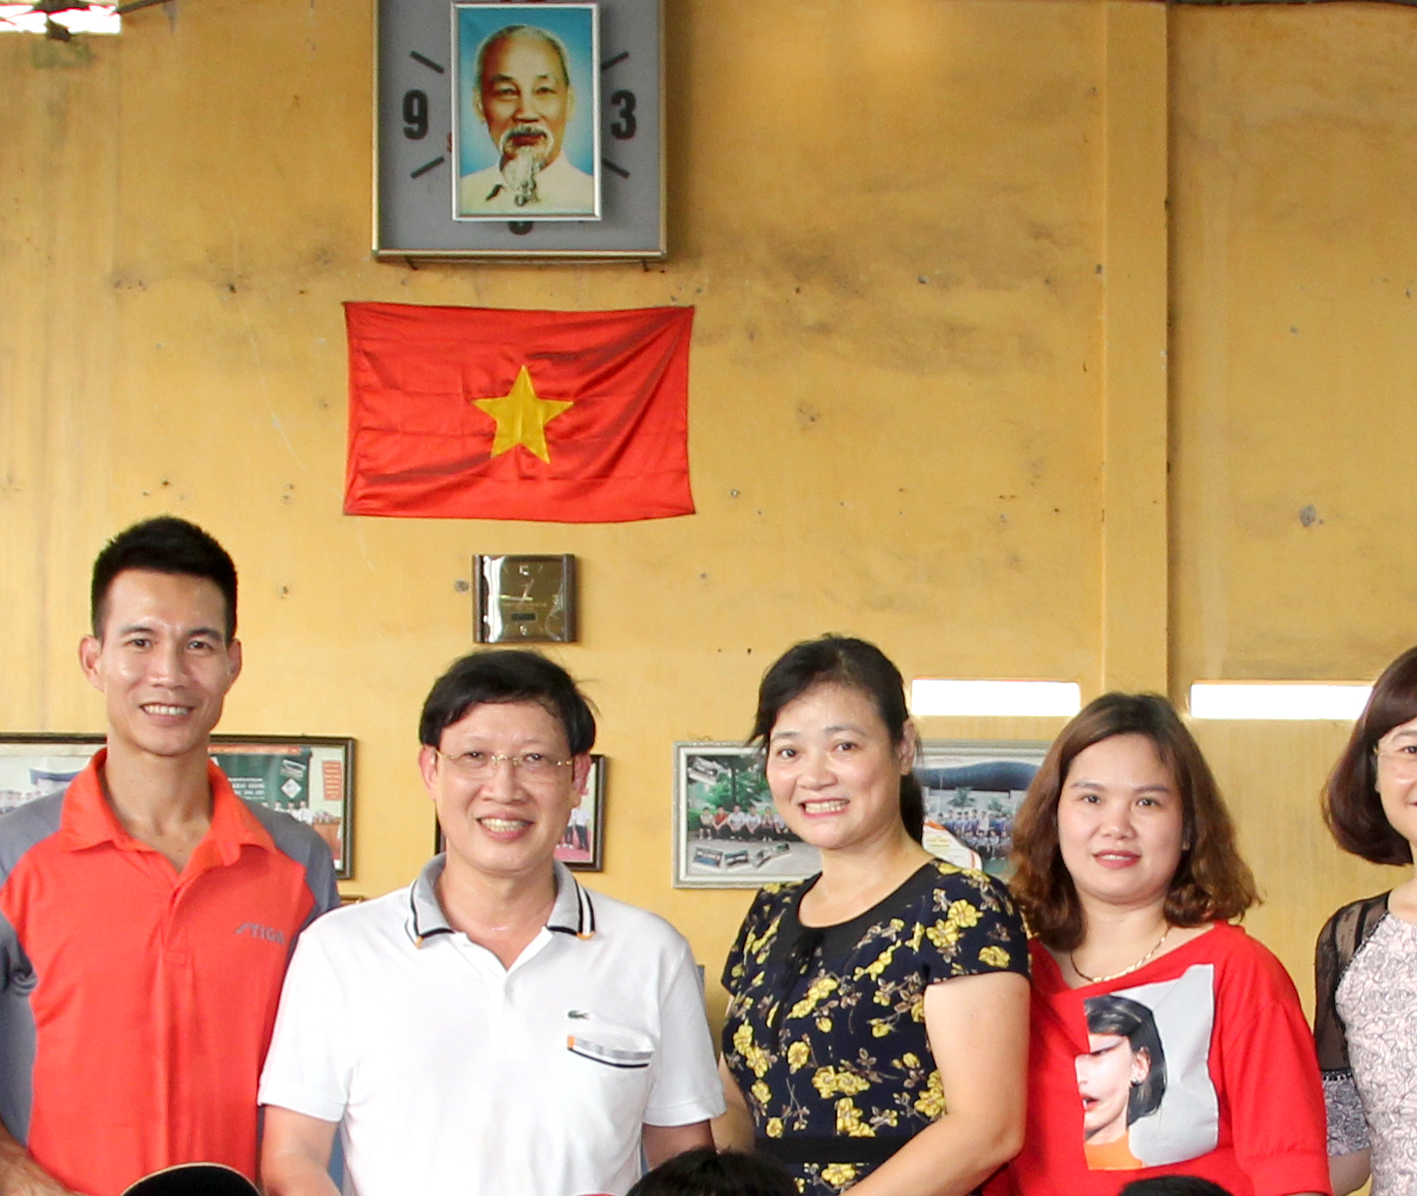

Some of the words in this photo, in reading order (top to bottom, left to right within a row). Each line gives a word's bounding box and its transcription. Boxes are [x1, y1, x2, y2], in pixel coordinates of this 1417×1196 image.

[402, 89, 429, 140] 9
[610, 89, 637, 140] 3
[235, 922, 285, 945] STIGA
